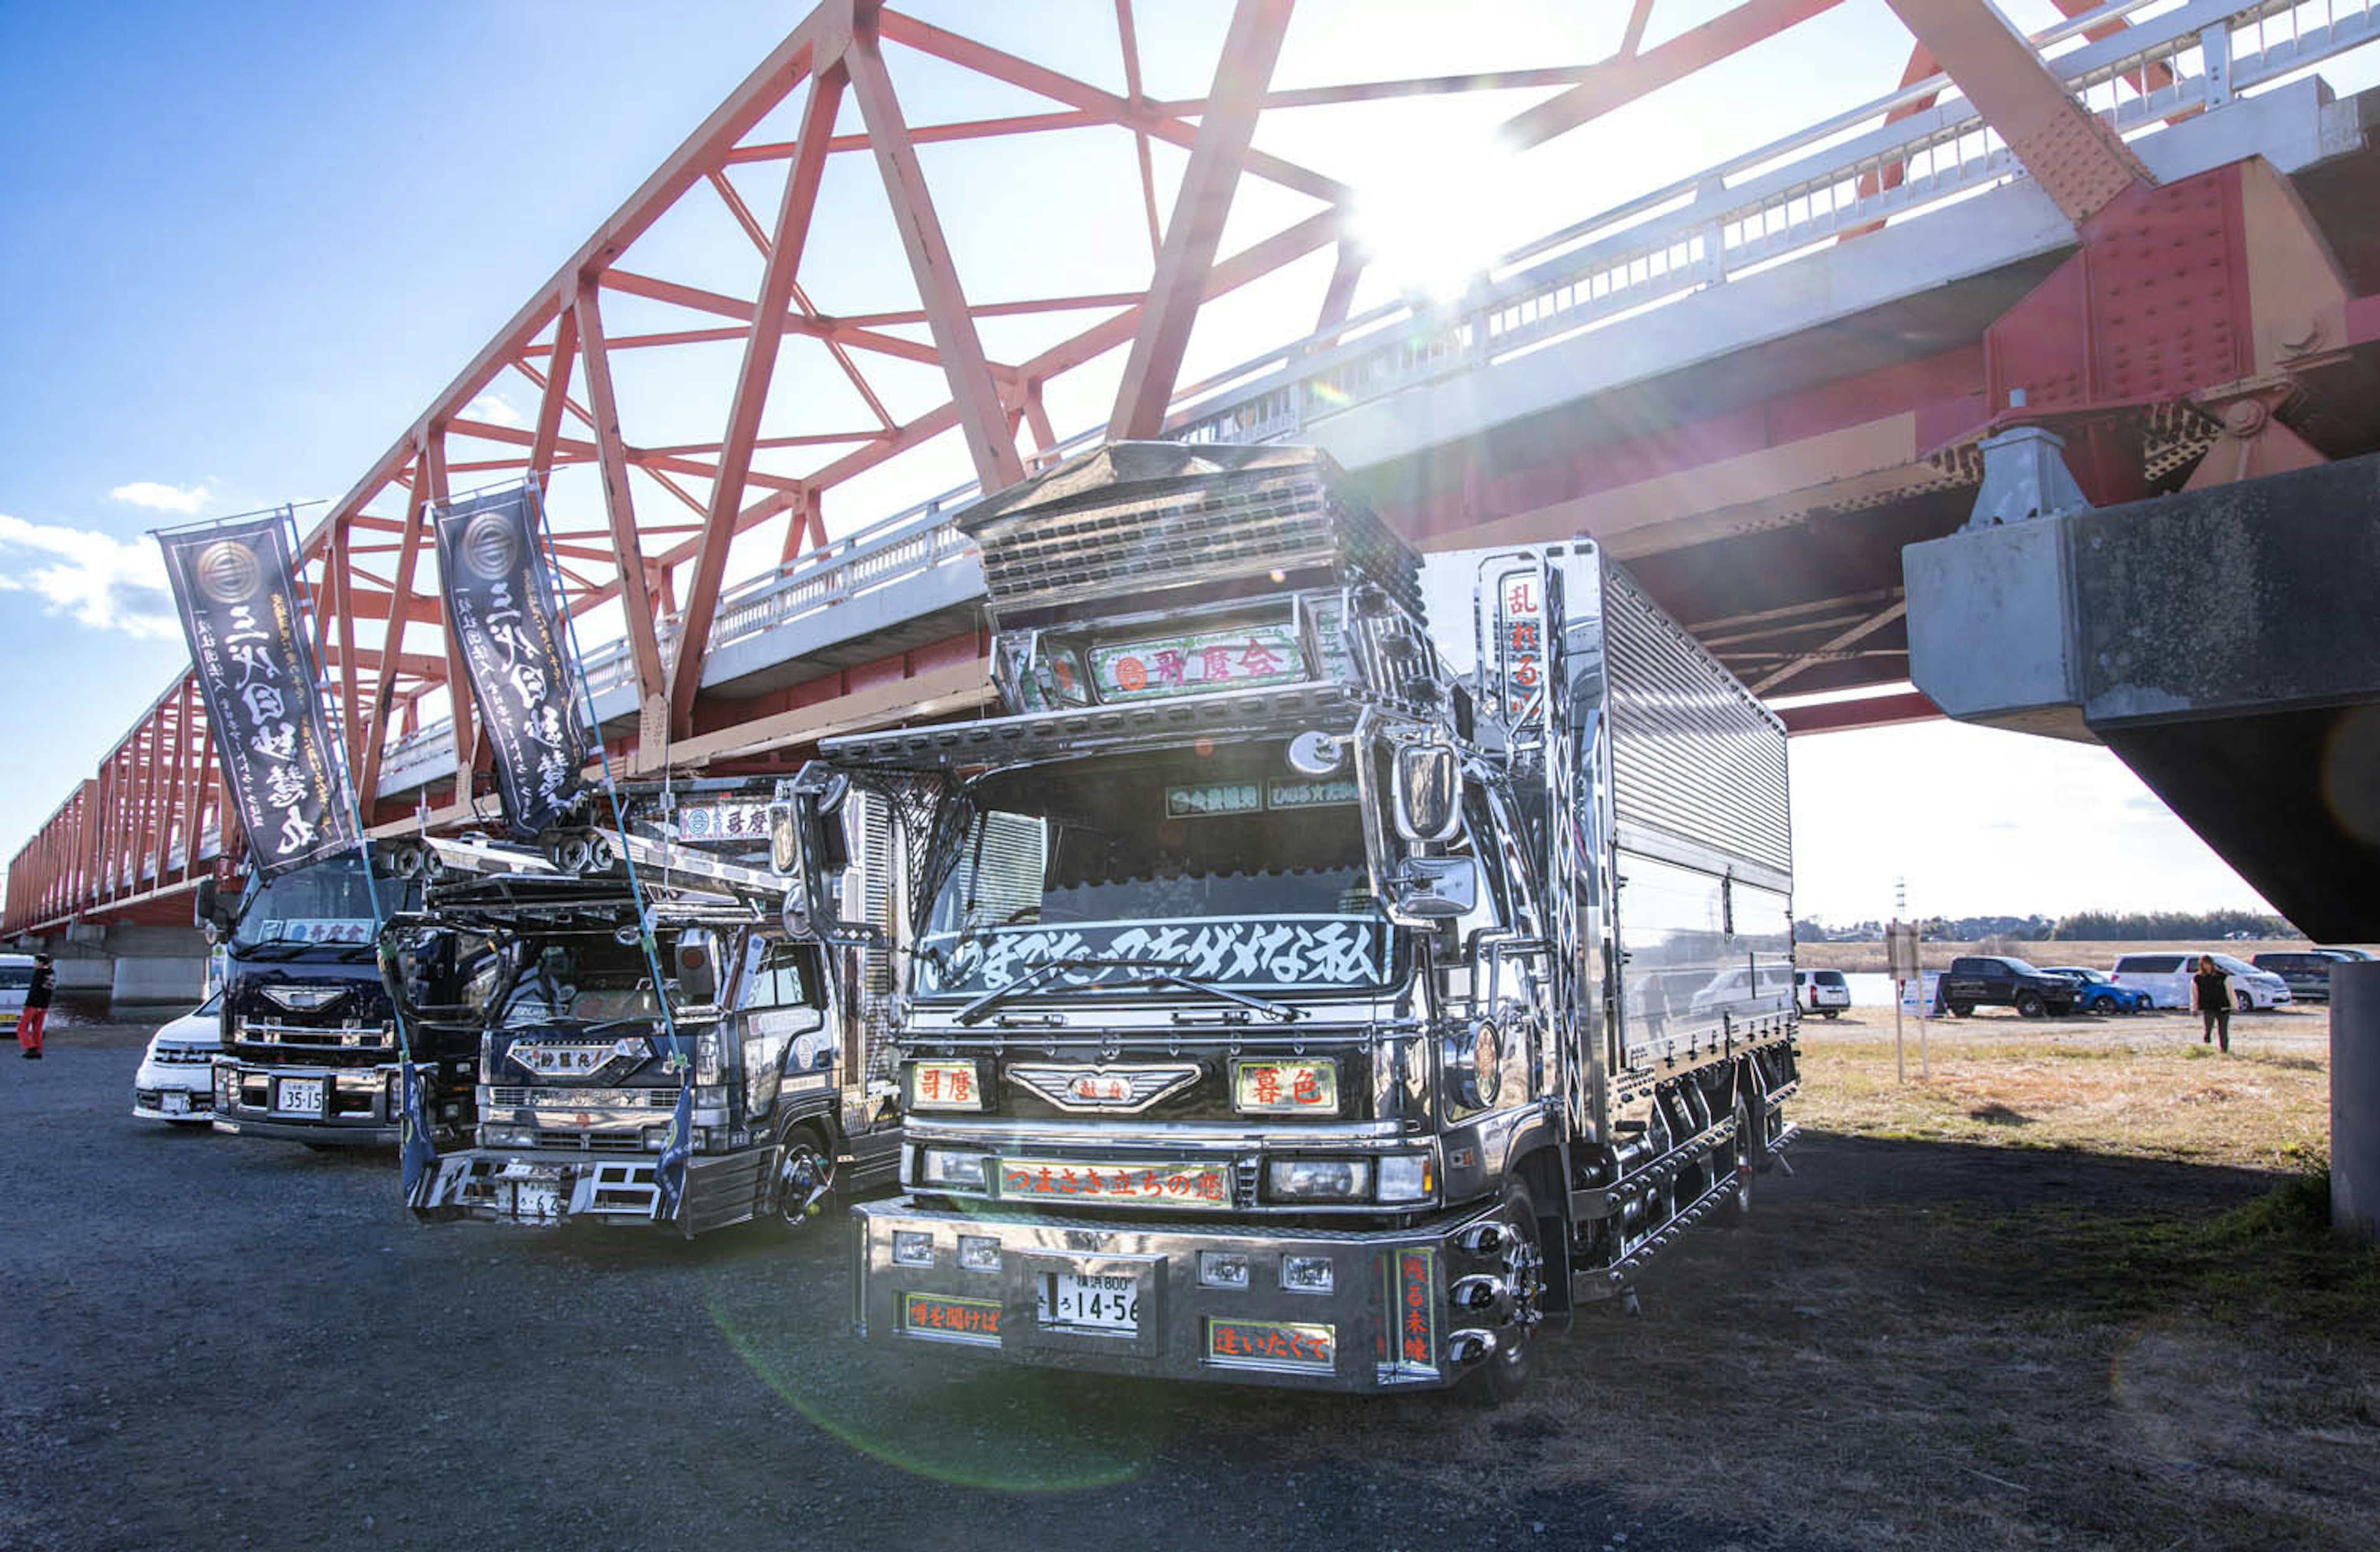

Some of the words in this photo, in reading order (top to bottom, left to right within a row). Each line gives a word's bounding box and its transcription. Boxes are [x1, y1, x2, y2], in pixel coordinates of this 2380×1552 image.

[1254, 1067, 1322, 1104] 暮色
[1006, 1166, 1222, 1201] つまさき立ちの恋
[1215, 1326, 1328, 1359] 逢いたくて
